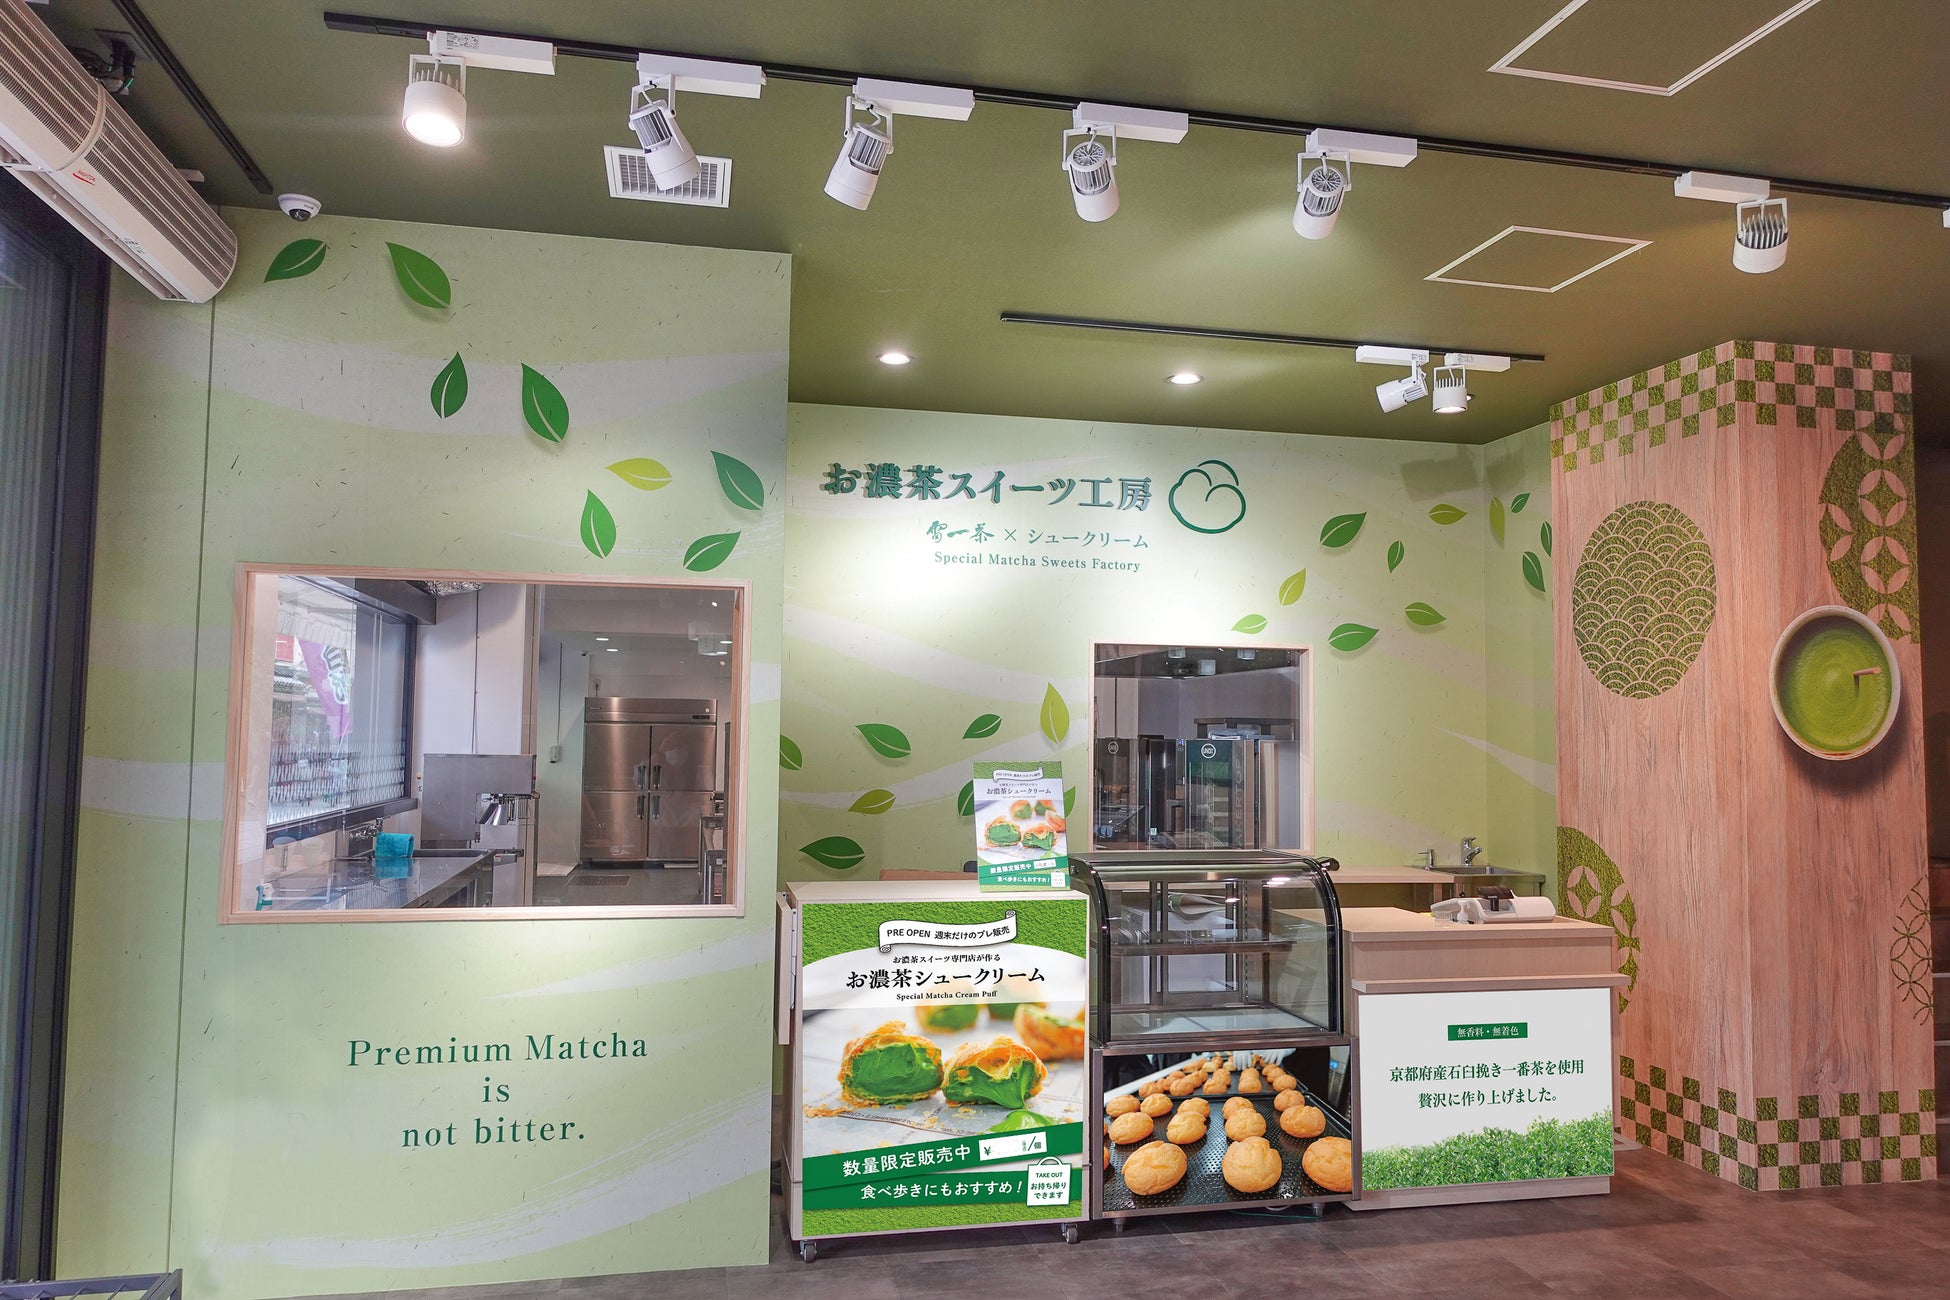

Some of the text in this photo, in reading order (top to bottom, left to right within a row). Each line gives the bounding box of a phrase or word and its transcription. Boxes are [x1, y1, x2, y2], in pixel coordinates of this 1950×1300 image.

[824, 463, 1153, 511] お濃茶スイーツ工房
[1028, 529, 1148, 548] シュークリーム
[935, 552, 1141, 572] Special Matcha Sweets Factory
[887, 926, 1010, 940] PRE OPEN 週末だけのプレ販売
[893, 954, 1001, 964] お濃茶スイーツ専門店が作る
[846, 967, 1045, 989] お濃茶シュークリーム
[896, 990, 998, 1001] Special Matcha Cream Puff
[1457, 1026, 1519, 1038] 無香料・無着色
[347, 1032, 647, 1066] Premium Matcha
[1389, 1059, 1584, 1082] 京都府産石臼挽き一番茶を使用
[483, 1077, 509, 1102] is
[1419, 1088, 1556, 1108] 贅沢に作り上げました。
[402, 1117, 584, 1148] not bitter.
[842, 1143, 971, 1177] 数量限定販売中
[861, 1181, 1022, 1199] 食べ歩きにもおすすめ！
[1030, 1182, 1067, 1191] お持ち帰り
